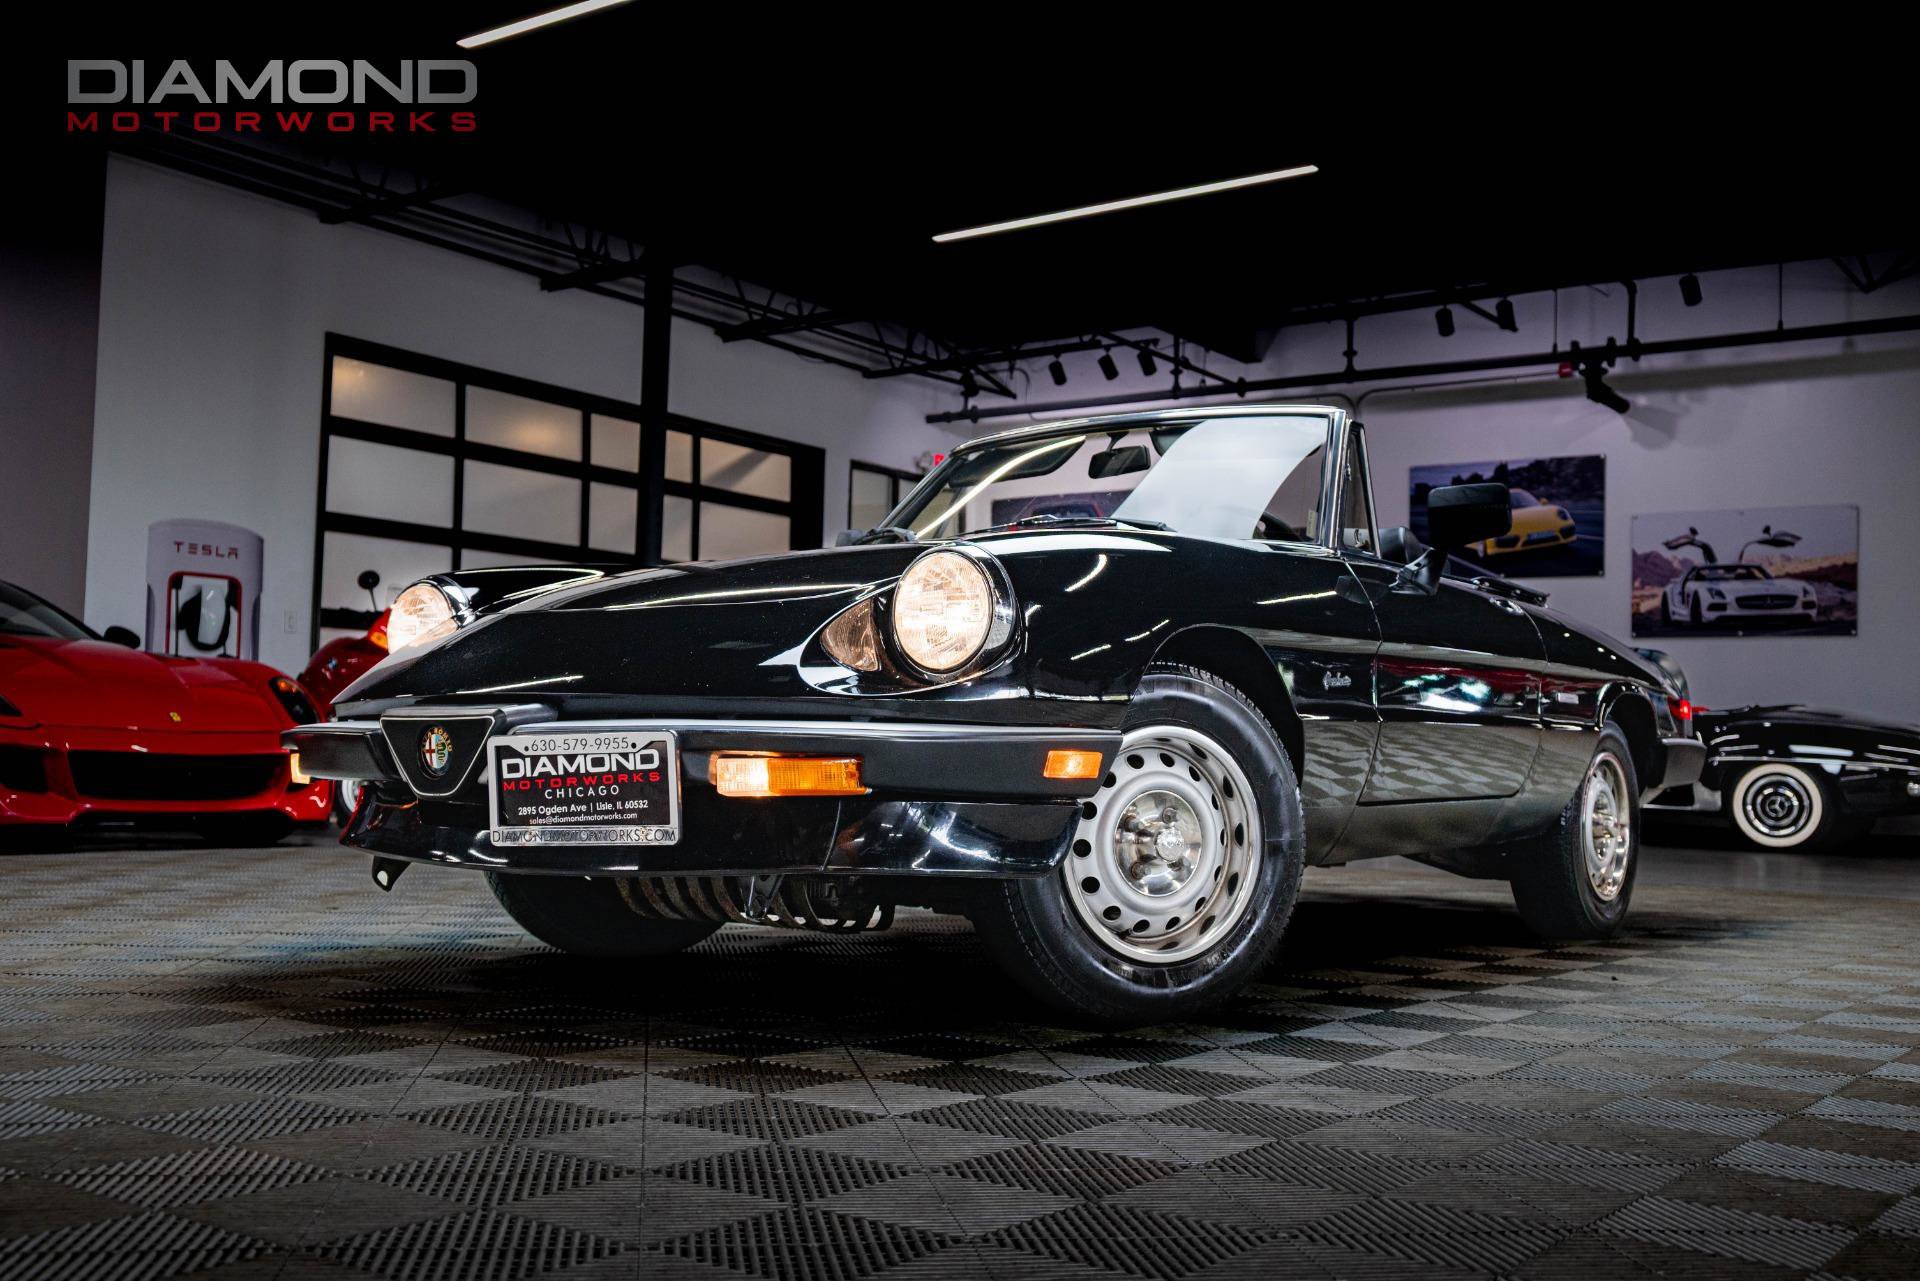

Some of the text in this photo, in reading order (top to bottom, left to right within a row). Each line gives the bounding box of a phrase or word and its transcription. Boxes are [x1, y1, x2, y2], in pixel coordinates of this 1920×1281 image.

[173, 541, 238, 559] TESLA
[531, 737, 629, 752] 630-579-9955
[502, 748, 660, 779] DIAMOND
[503, 771, 661, 792] MOTORWORKS
[544, 785, 620, 799] CHICAGO
[518, 806, 537, 816] 2895
[538, 805, 568, 816] Ogden
[570, 804, 587, 813] Ave
[617, 801, 623, 810] IL
[624, 799, 648, 809] 60532
[529, 812, 638, 825] sales@diamondmotorworks.com
